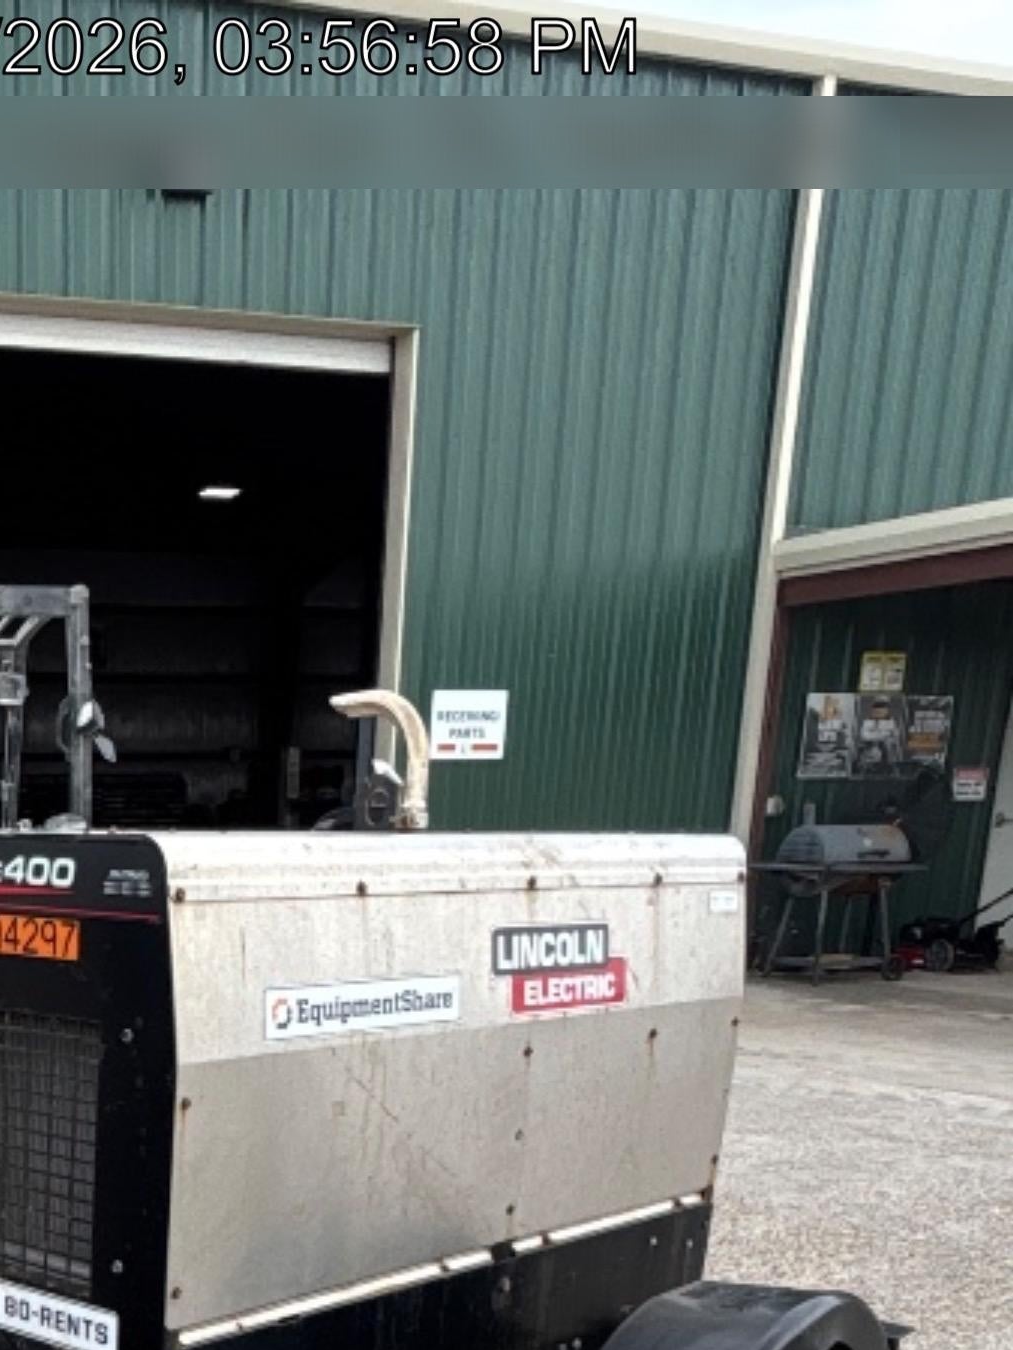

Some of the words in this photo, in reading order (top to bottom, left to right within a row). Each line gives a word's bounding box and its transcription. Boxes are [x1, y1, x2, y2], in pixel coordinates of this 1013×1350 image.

[448, 728, 486, 739] PARTS
[496, 930, 604, 969] LINCOLN
[523, 973, 617, 1006] ELECTRIC
[296, 989, 453, 1026] EquipmentShare
